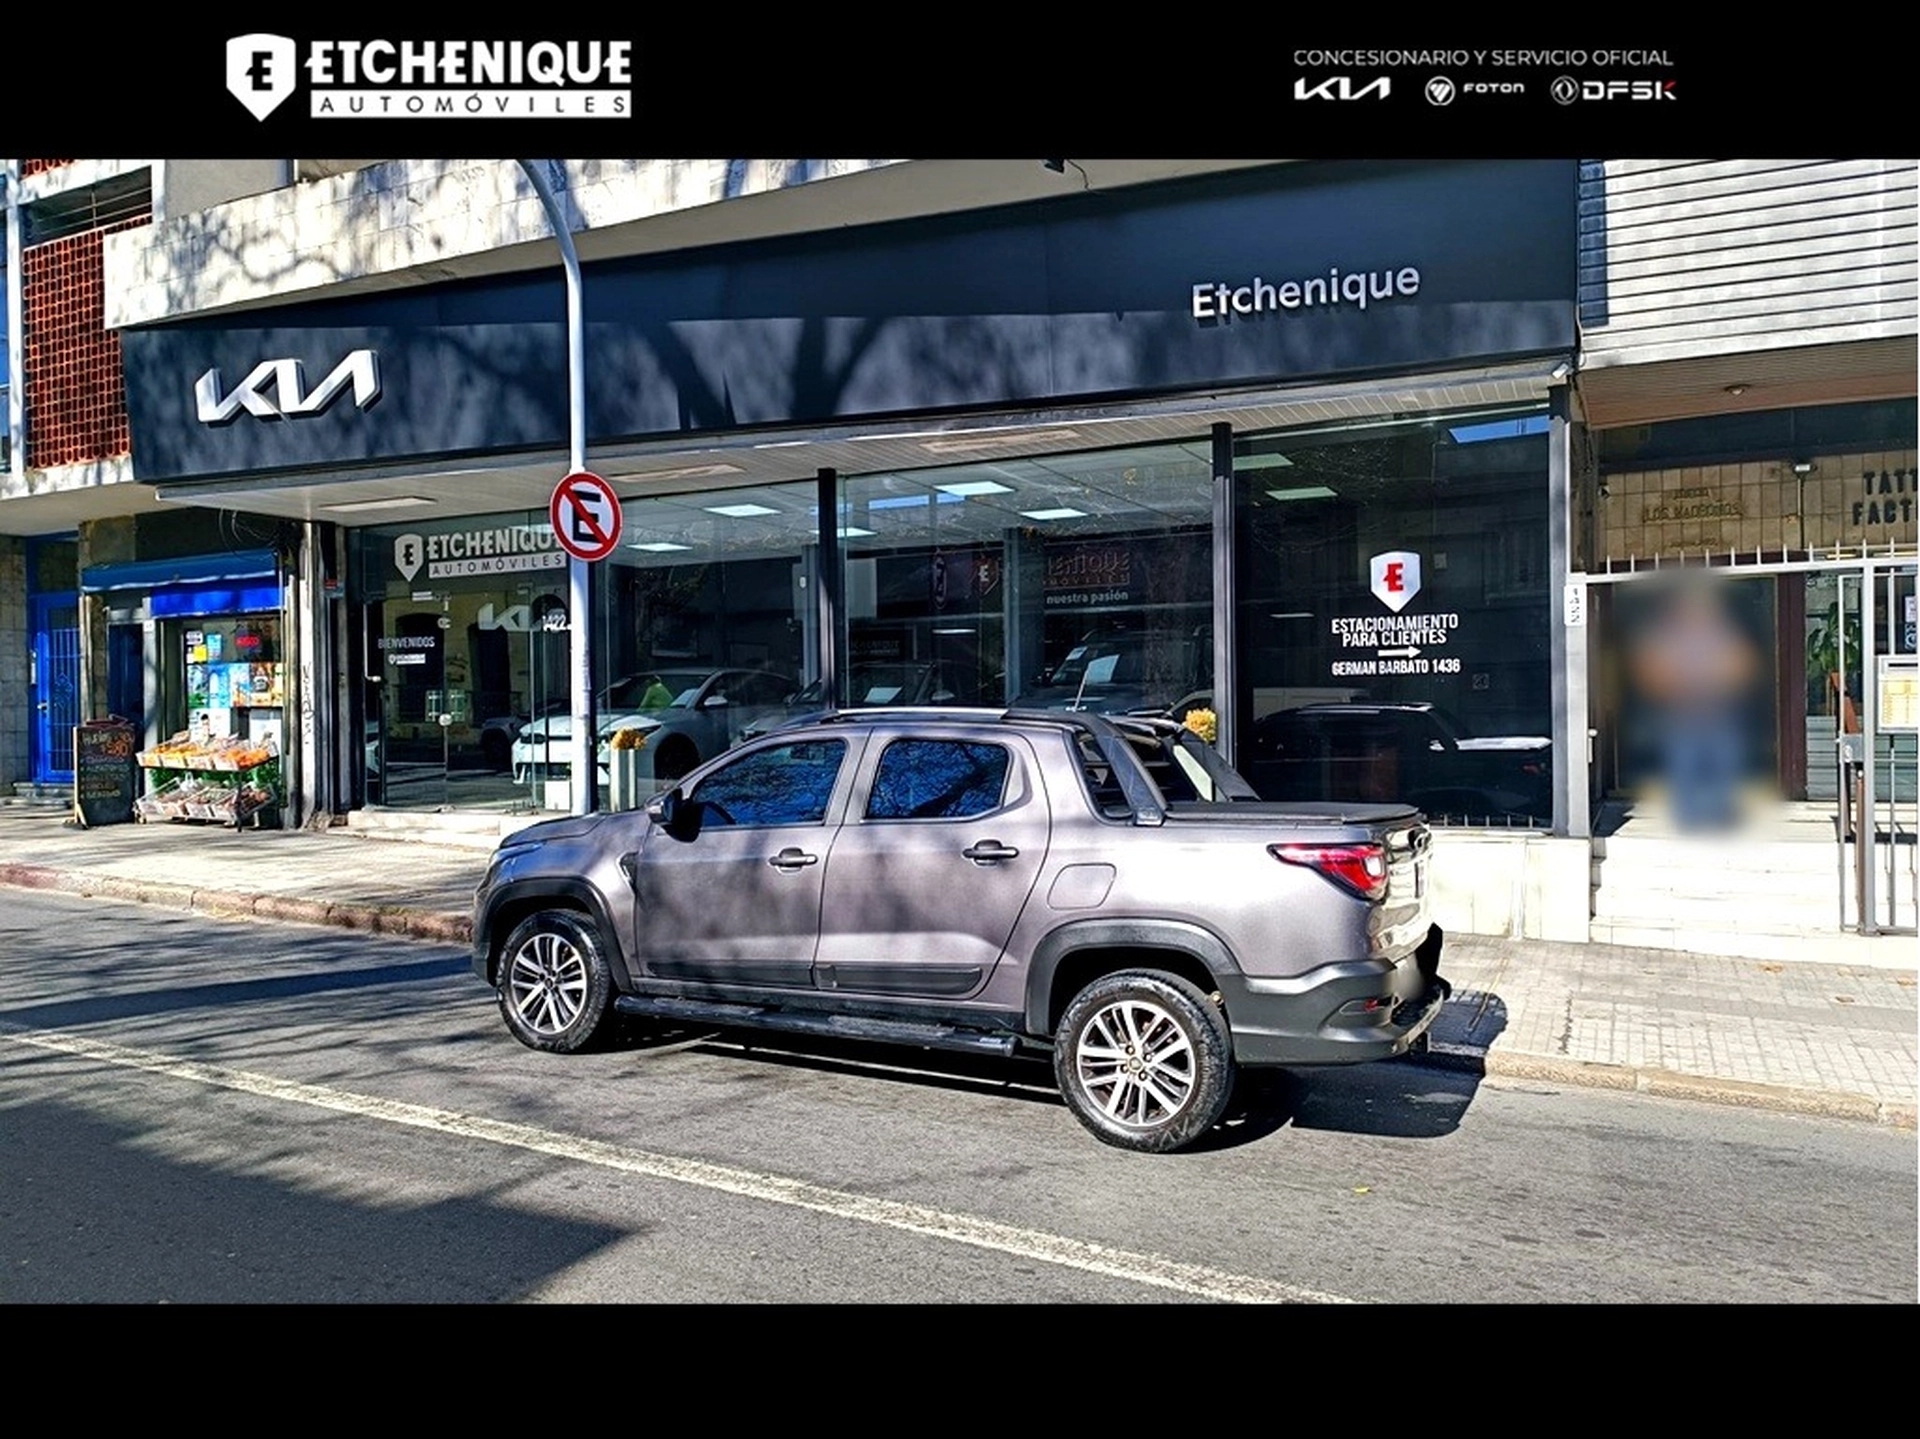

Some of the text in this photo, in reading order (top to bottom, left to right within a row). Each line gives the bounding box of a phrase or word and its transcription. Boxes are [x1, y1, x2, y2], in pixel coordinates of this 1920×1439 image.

[1192, 267, 1420, 318] Etchenique
[195, 349, 380, 423] KIA
[1852, 498, 1918, 527] FACT
[432, 553, 562, 576] AUTOMÓVILES
[1046, 588, 1129, 605] nuestra pasión
[1331, 613, 1459, 634] ESTACIONAMIENTO
[378, 636, 436, 649] BIENVENIDOS
[1342, 629, 1447, 647] PARA CLIENTES
[1331, 661, 1377, 676] GERMAN
[1378, 659, 1430, 674] BARBATO
